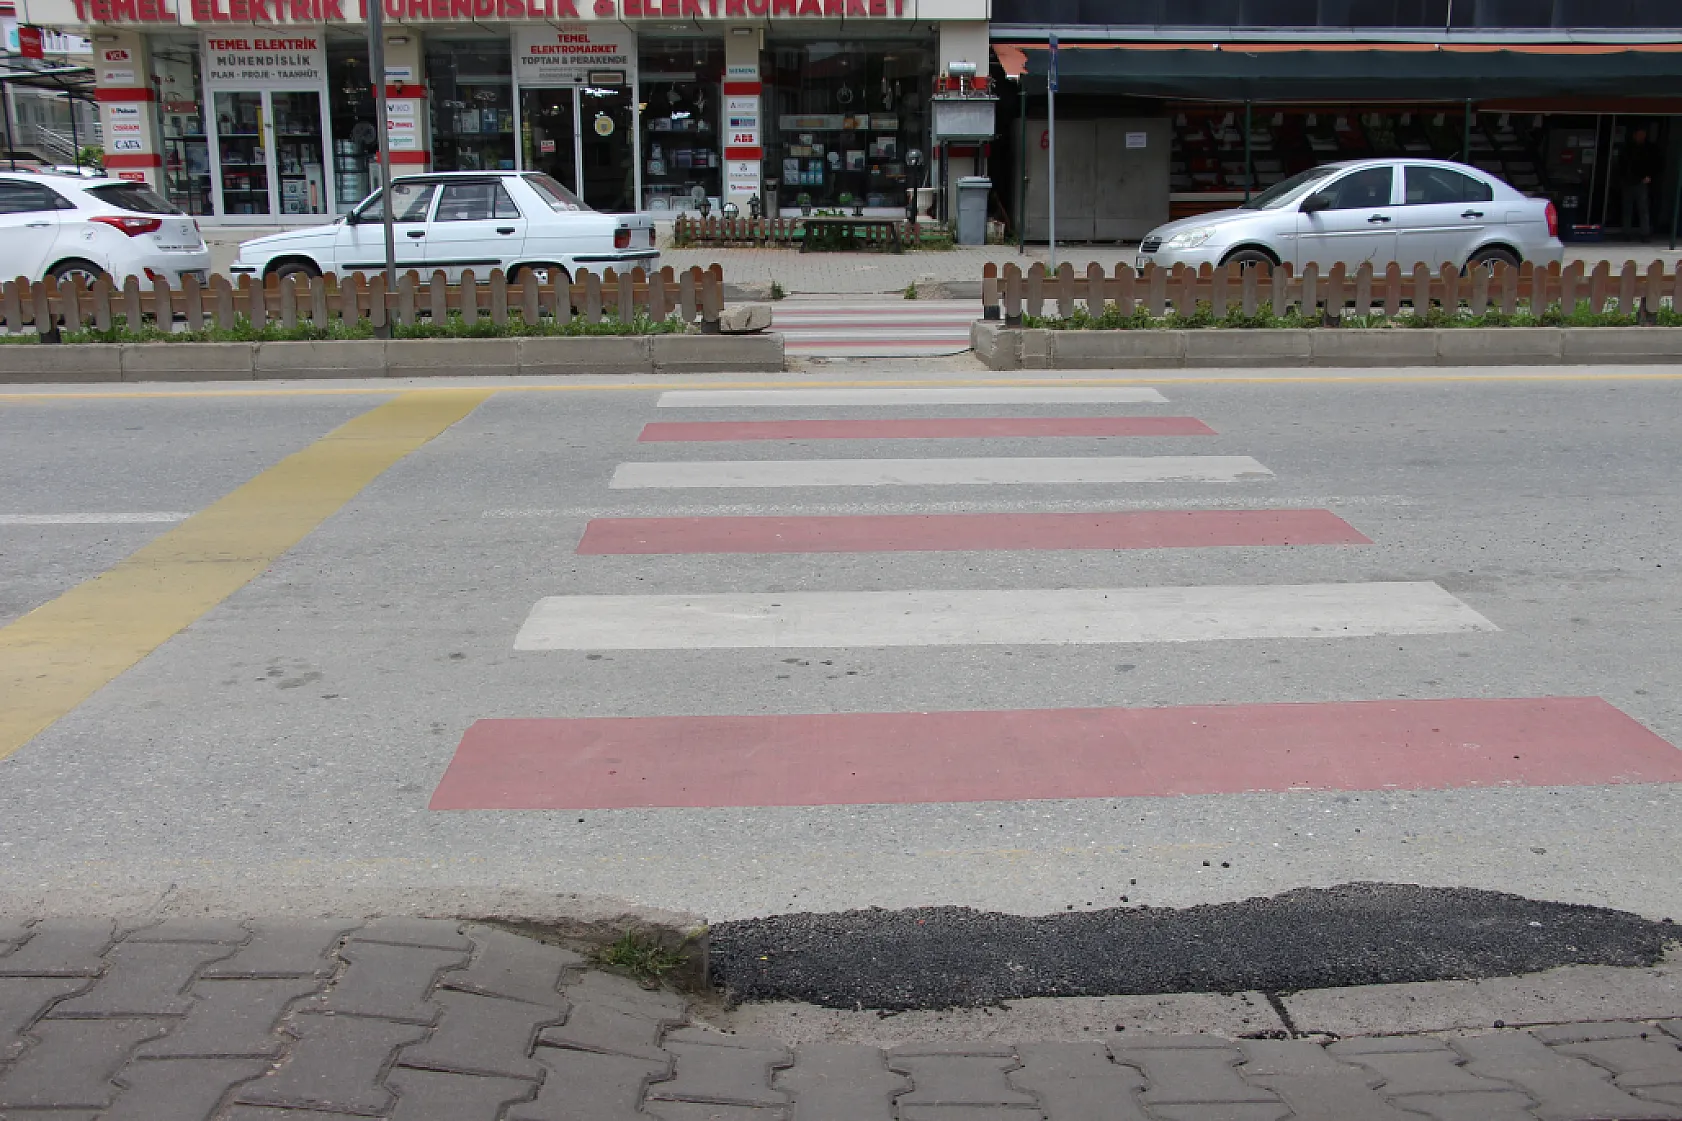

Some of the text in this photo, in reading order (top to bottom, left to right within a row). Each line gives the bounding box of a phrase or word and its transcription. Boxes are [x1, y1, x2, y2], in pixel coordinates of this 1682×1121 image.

[72, 0, 177, 22] TEMEL
[624, 0, 909, 17] ELEKTROMARKET
[558, 34, 590, 43] TEMEL
[208, 39, 252, 50] TEMEL
[530, 44, 618, 54] ELEKTROMARKET
[217, 54, 311, 66] MÜHENDİSLİK
[521, 56, 560, 65] TOPTAN
[570, 56, 628, 65] PERAKENDE
[210, 71, 235, 79] PLAN
